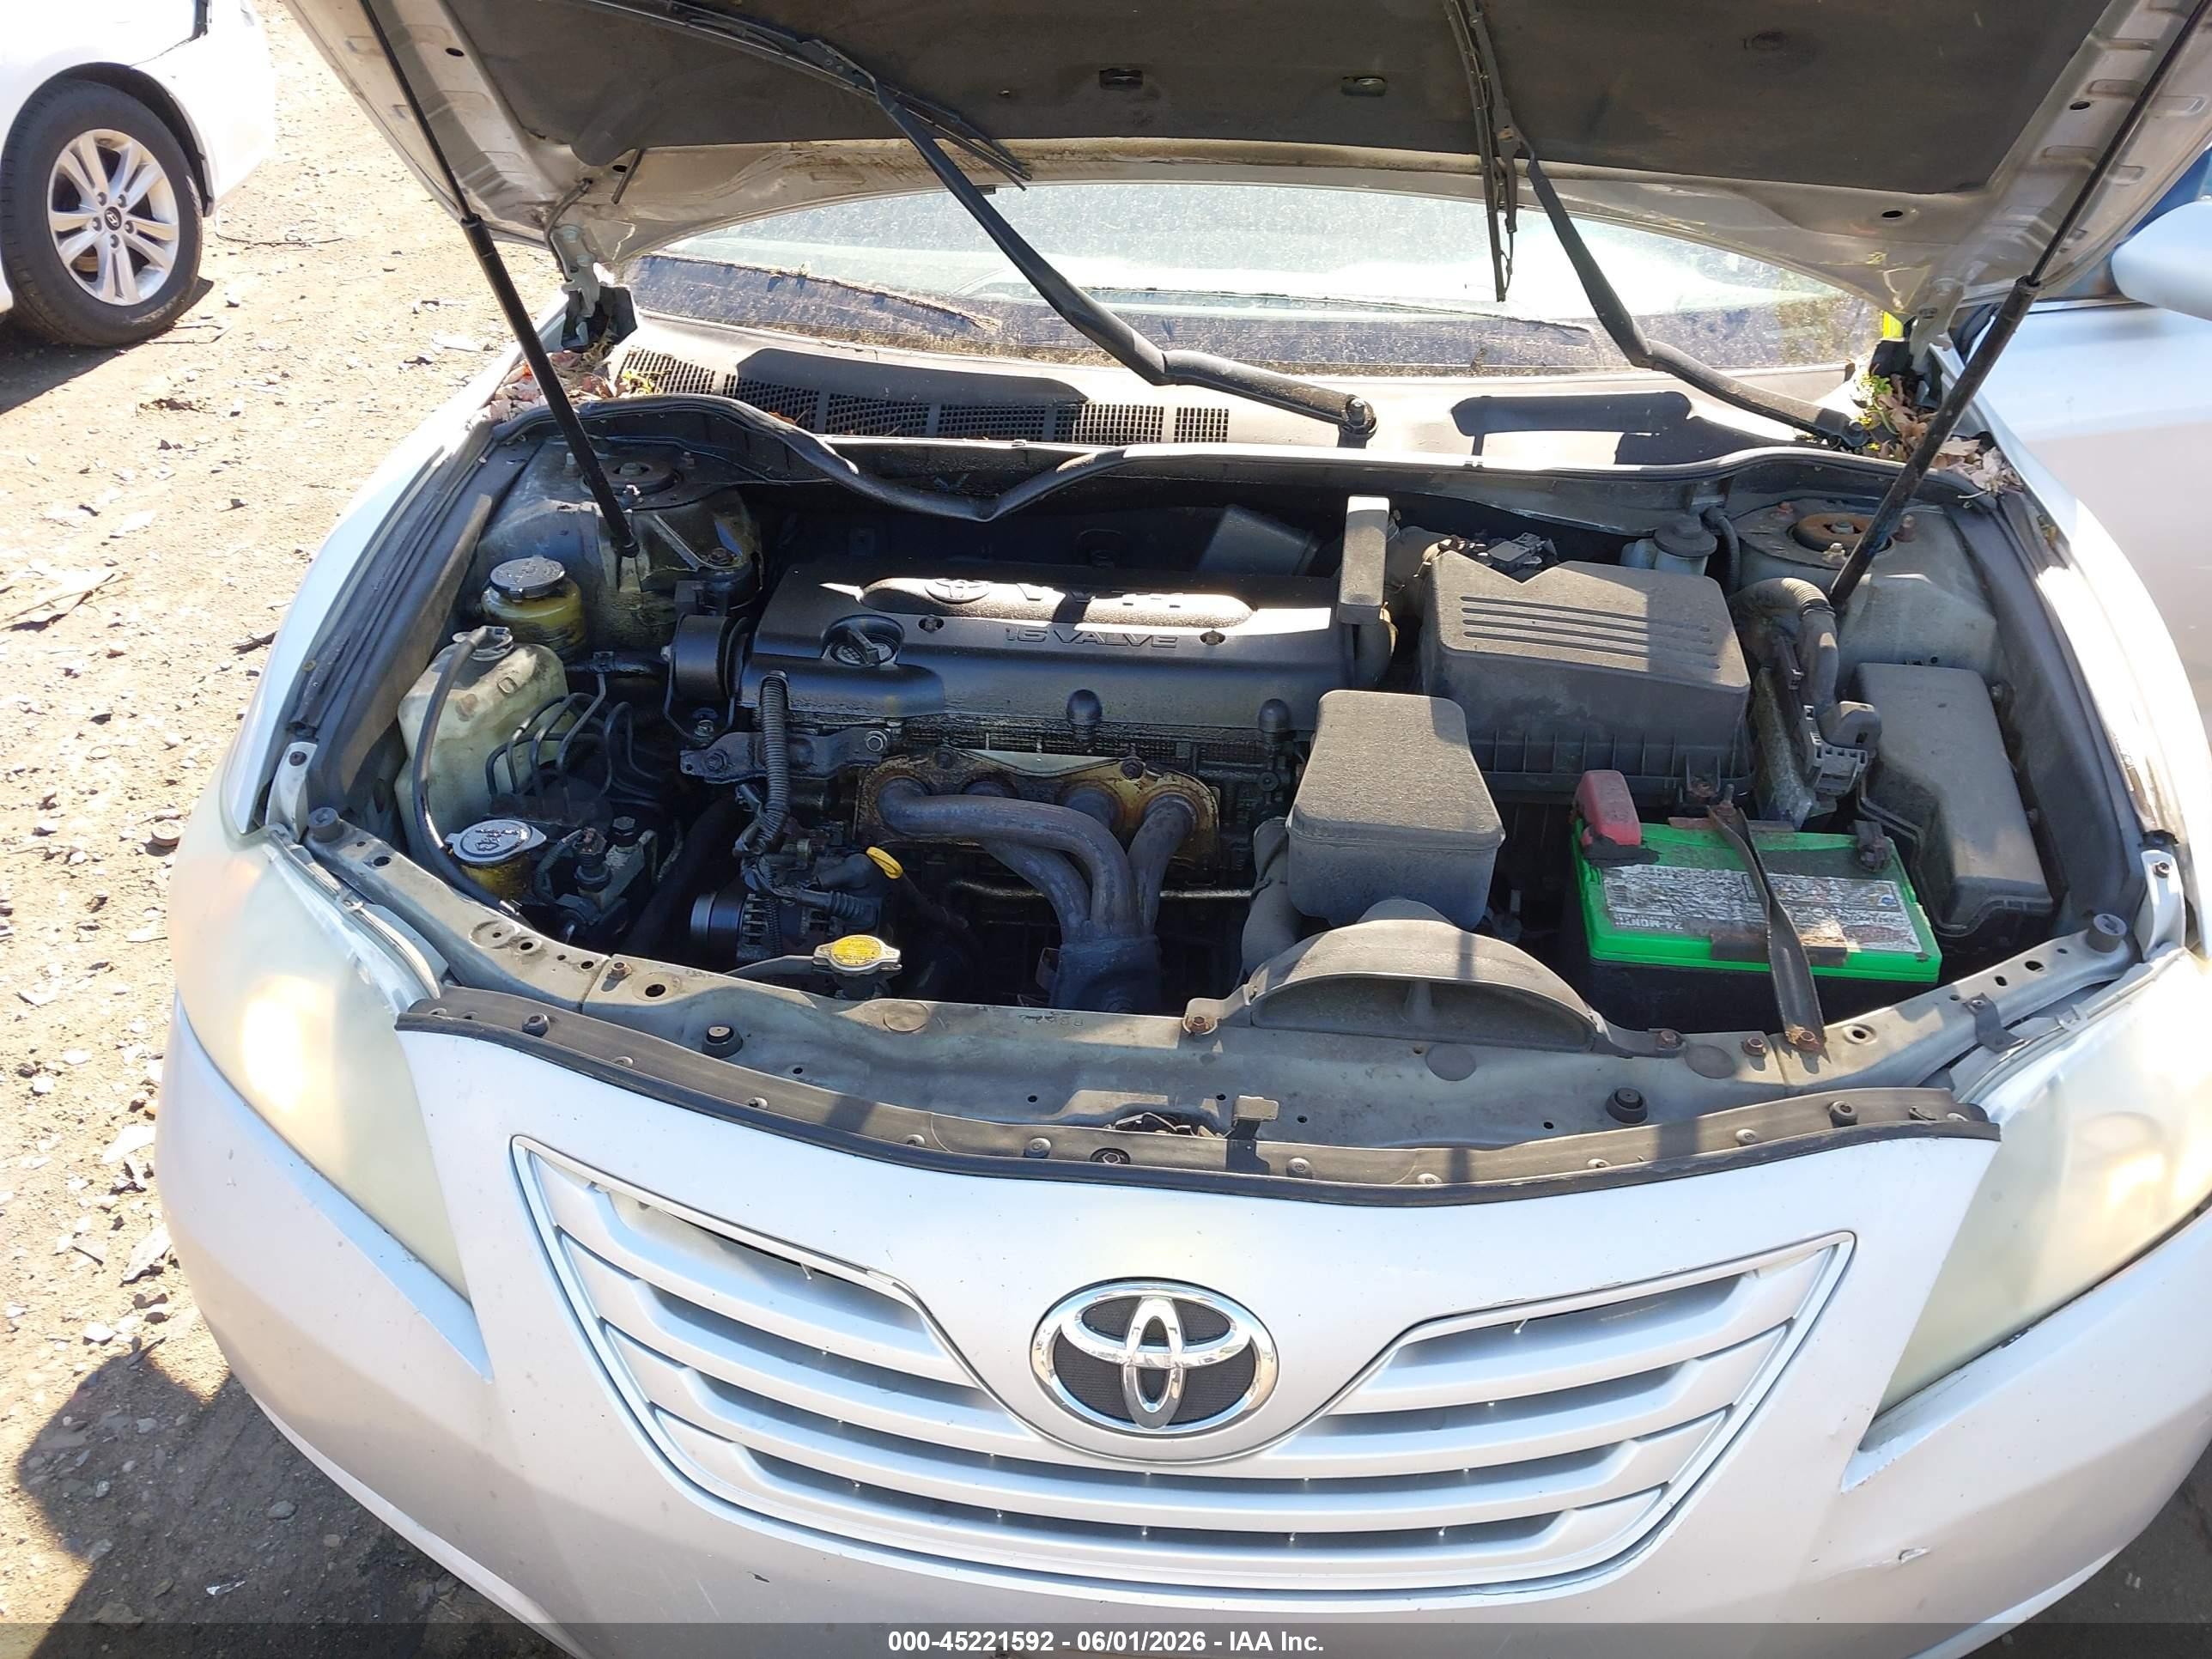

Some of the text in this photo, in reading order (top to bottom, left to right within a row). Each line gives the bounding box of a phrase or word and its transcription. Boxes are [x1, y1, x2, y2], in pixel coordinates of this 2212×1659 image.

[1006, 627, 1179, 648] 16 VALVE
[1614, 918, 1684, 931] 24-MON
